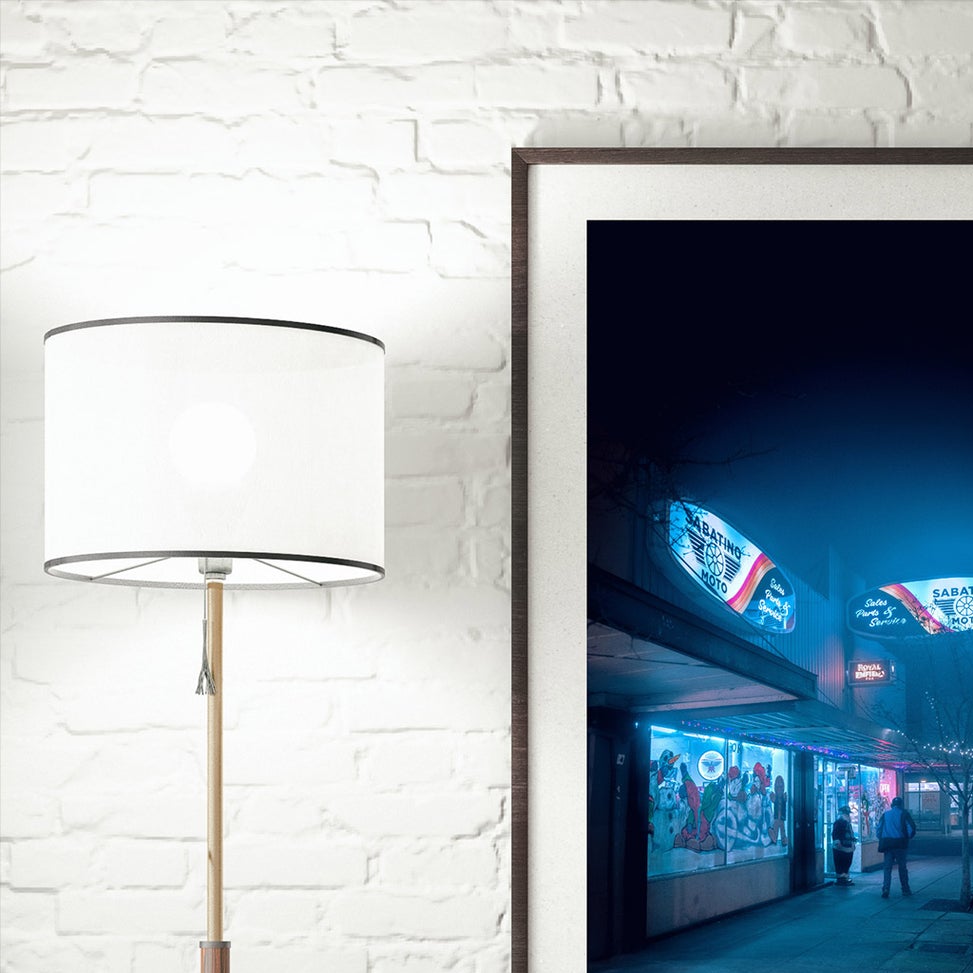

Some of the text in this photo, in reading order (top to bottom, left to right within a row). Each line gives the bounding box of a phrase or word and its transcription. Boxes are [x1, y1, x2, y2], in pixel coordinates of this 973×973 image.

[685, 510, 742, 559] SABATINO
[701, 569, 728, 594] MOTO
[770, 578, 785, 596] Sales
[765, 589, 781, 607] Parts
[865, 598, 888, 608] Sales
[758, 599, 782, 622] Service
[856, 606, 897, 619] Parts &
[869, 617, 906, 627] Service
